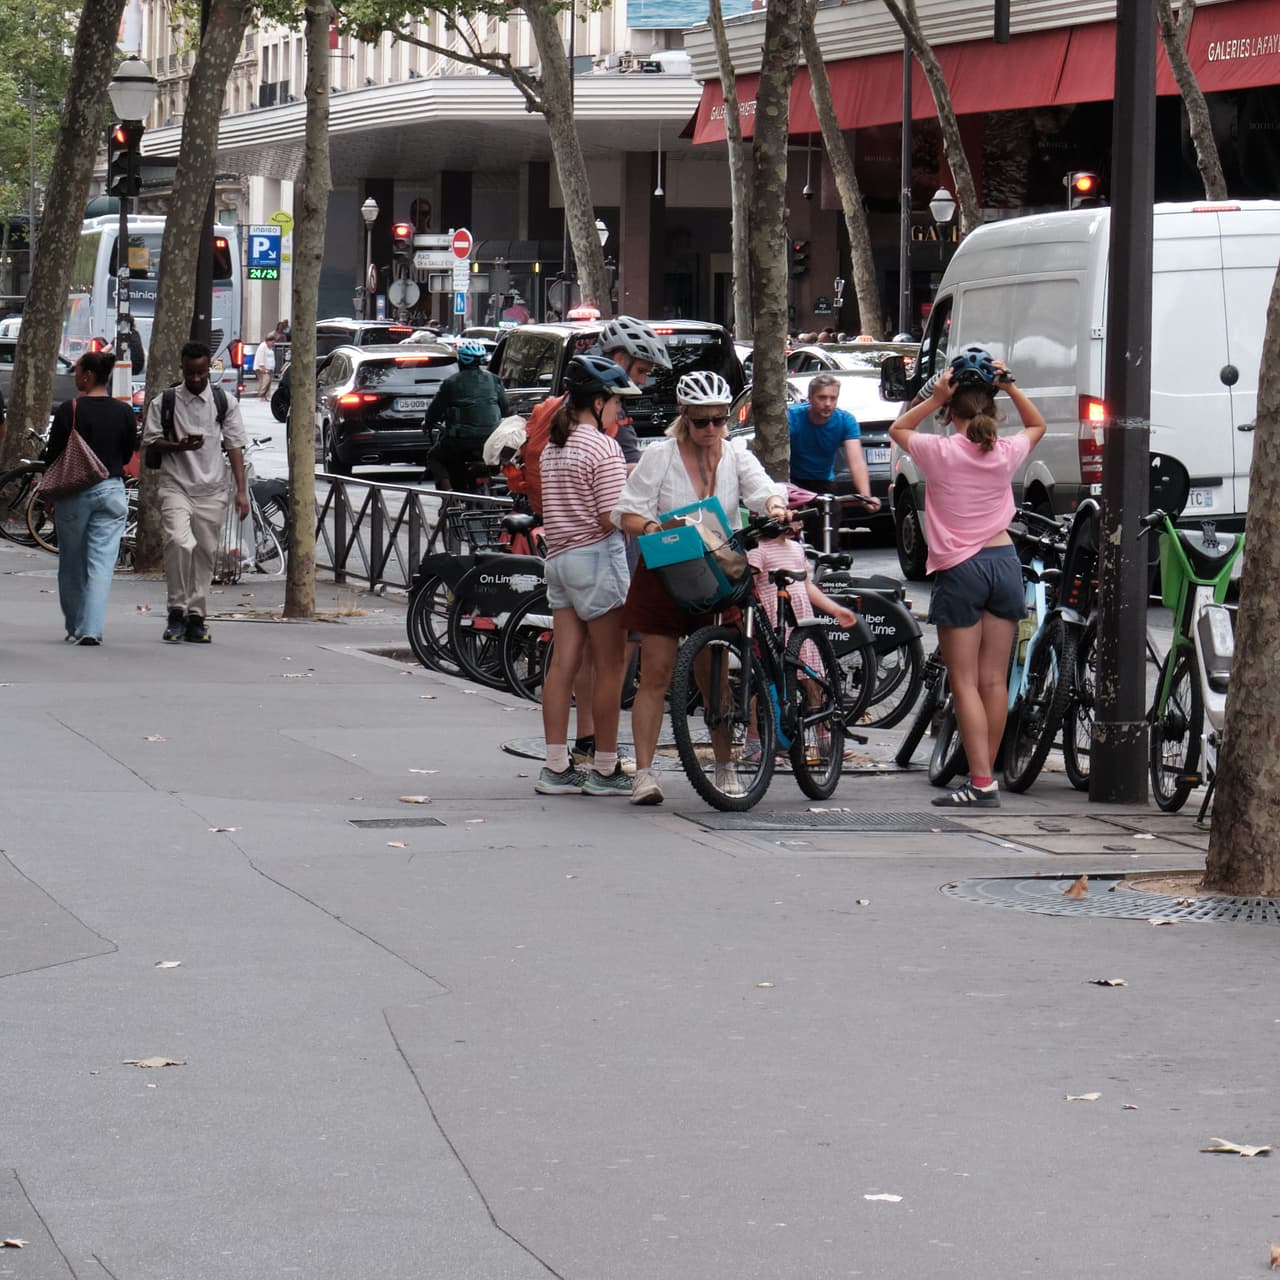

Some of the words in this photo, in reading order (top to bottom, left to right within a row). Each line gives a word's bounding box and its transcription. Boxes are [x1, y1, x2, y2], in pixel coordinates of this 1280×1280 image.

[1208, 38, 1250, 62] GALERIES
[253, 237, 271, 258] P
[250, 269, 278, 279] 24/24
[480, 574, 494, 584] On
[495, 574, 513, 585] Lim
